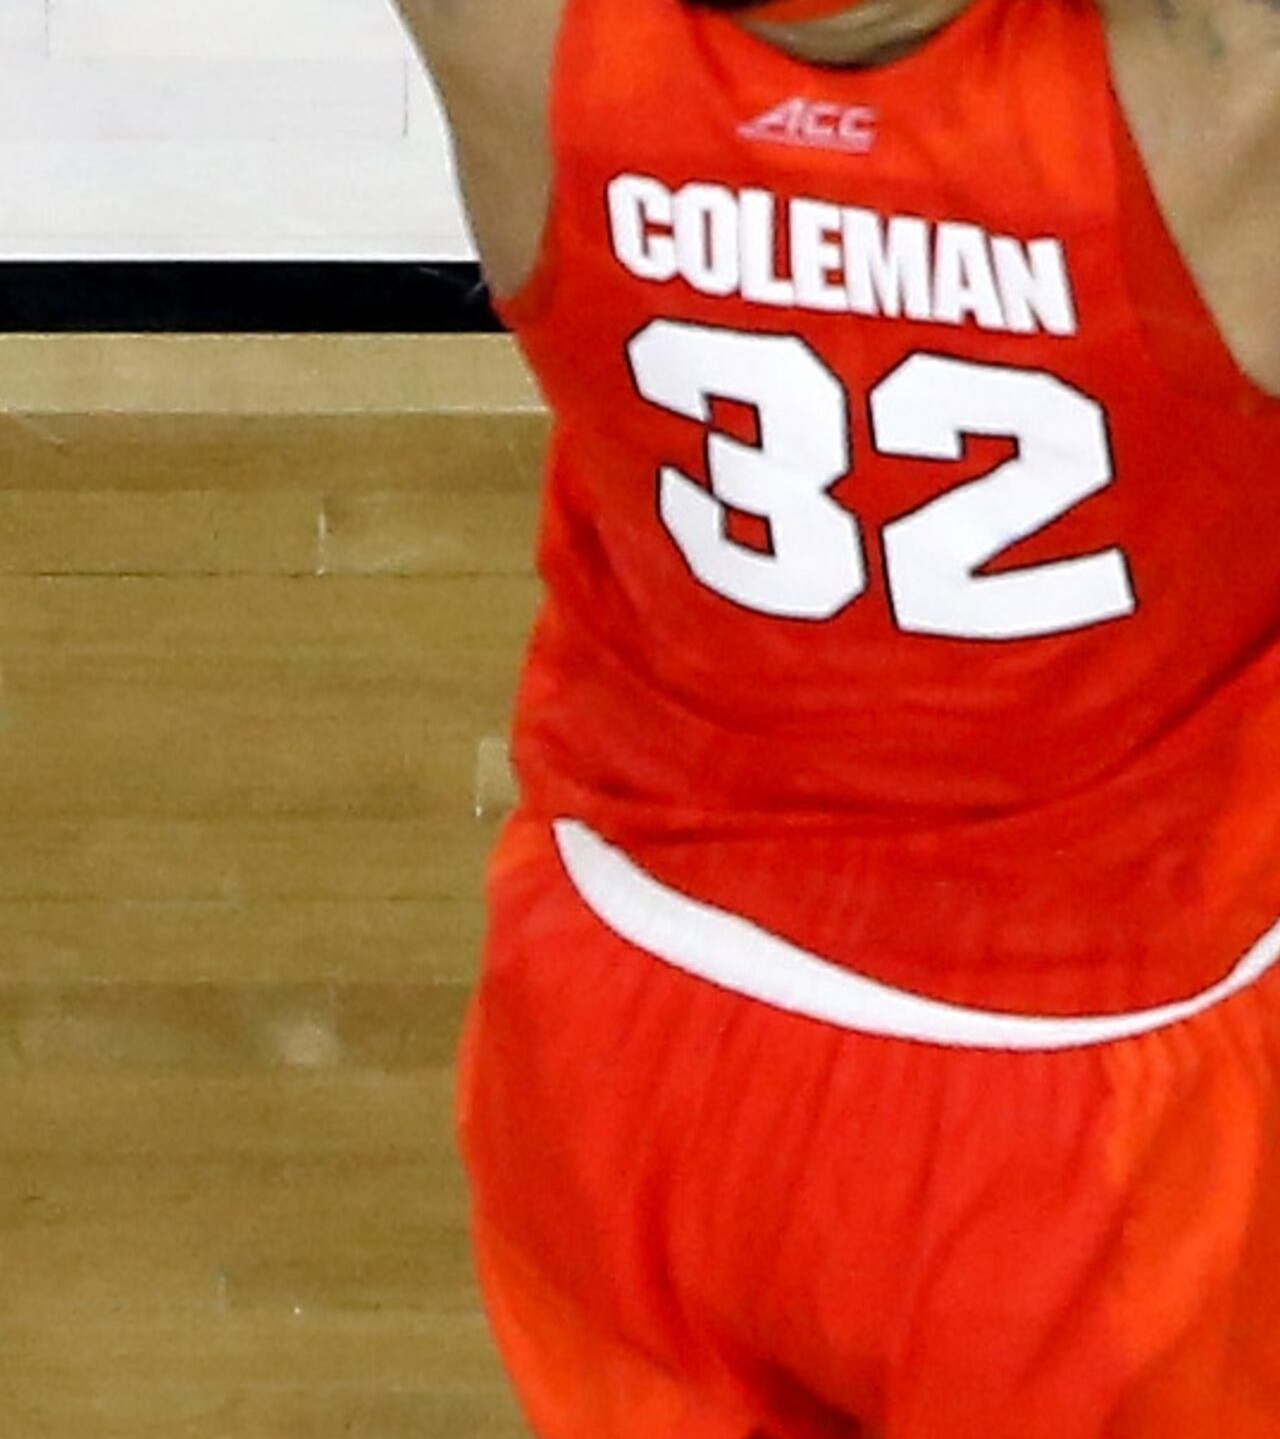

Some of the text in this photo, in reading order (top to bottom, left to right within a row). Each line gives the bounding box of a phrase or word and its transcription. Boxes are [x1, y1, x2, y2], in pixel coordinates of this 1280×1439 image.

[736, 97, 878, 154] ACC
[606, 172, 1077, 337] COLEMAN
[627, 319, 1137, 642] 32
